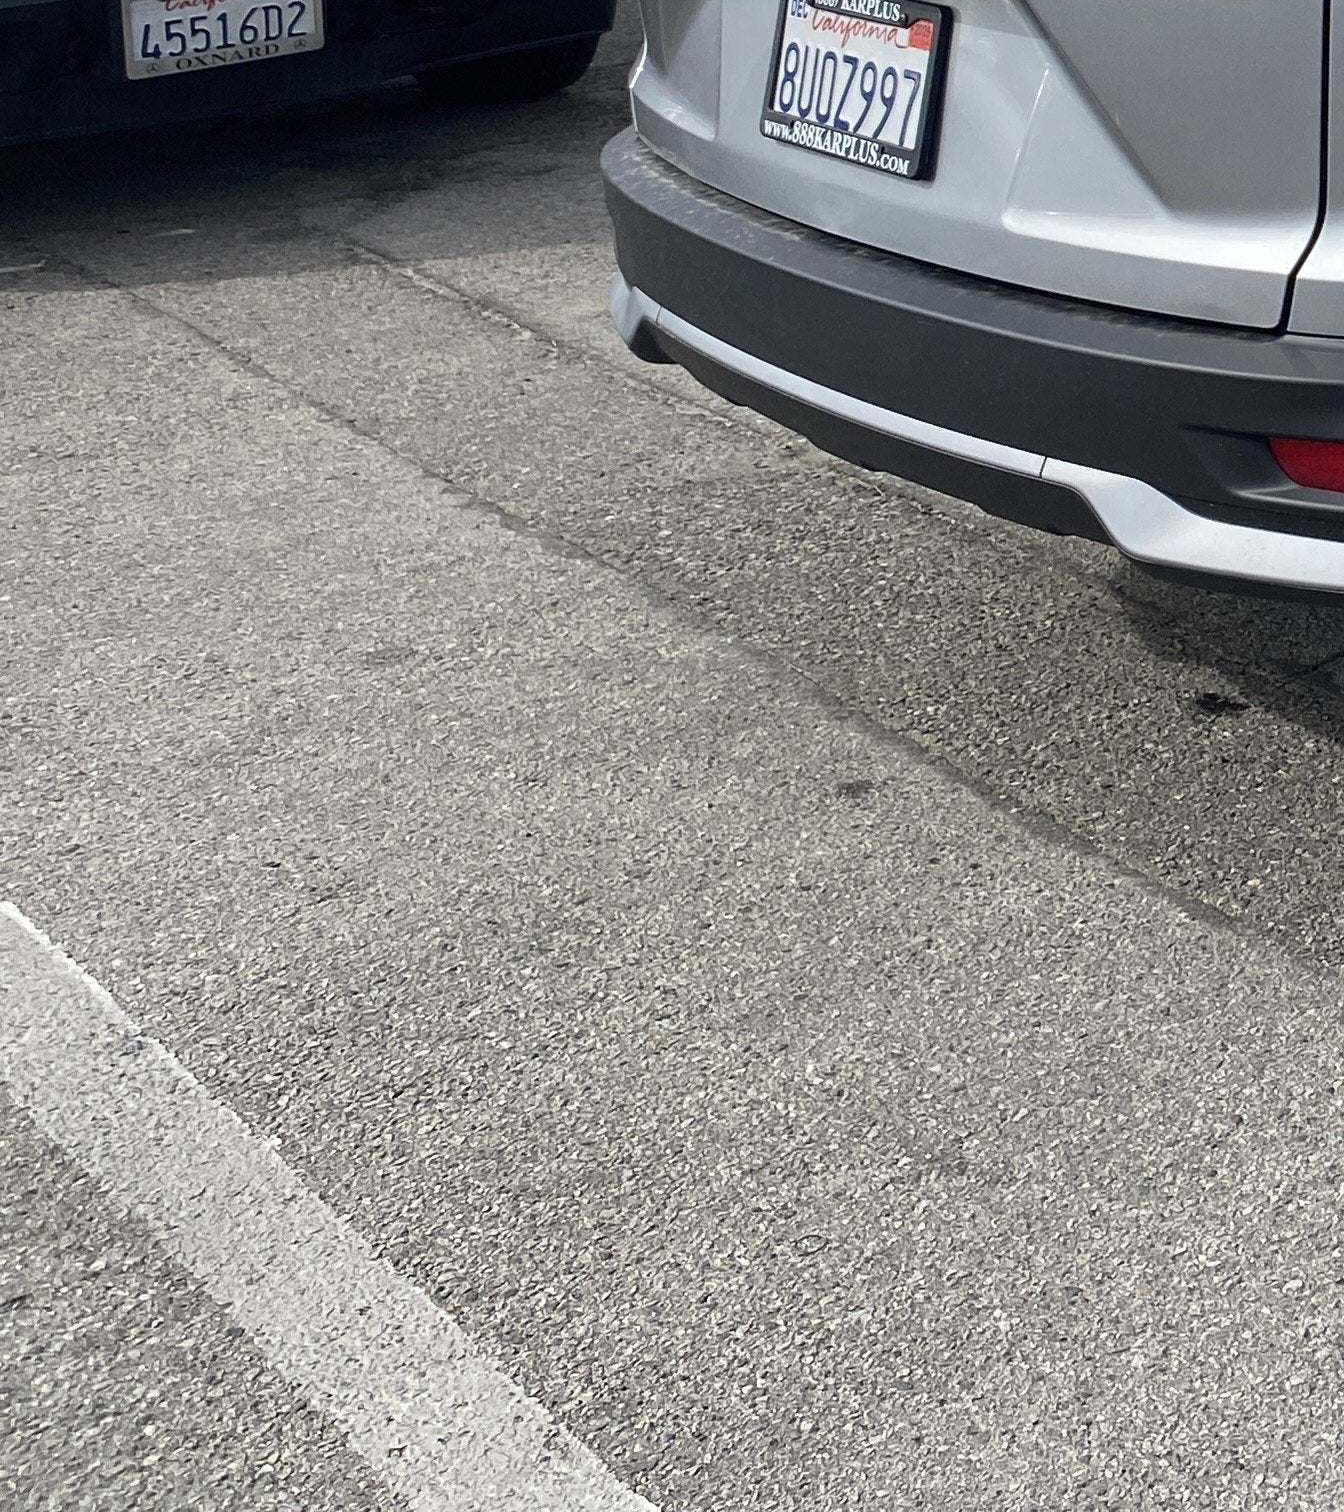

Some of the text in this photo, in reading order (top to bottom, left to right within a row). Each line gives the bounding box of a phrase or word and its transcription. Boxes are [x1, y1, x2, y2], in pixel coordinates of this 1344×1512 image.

[140, 0, 307, 59] 45516D2
[811, 9, 909, 49] California
[175, 43, 280, 71] OXNARD
